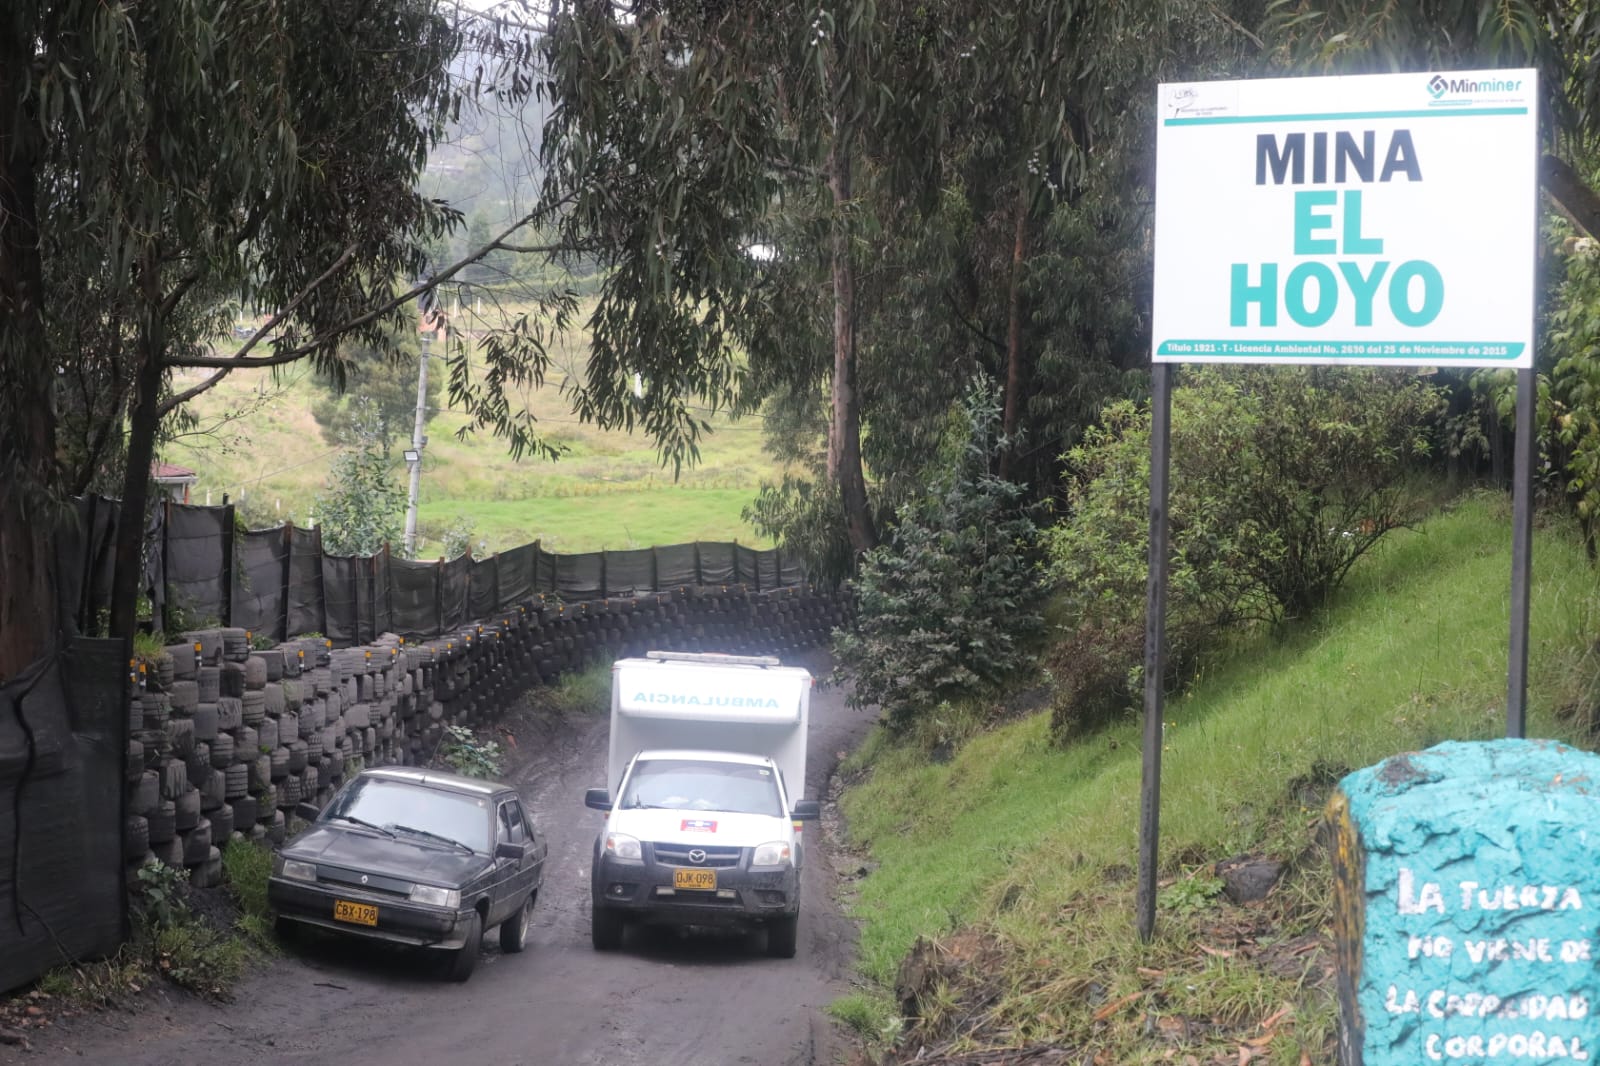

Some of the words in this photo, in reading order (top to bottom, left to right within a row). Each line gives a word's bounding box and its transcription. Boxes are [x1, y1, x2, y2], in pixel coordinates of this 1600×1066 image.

[1450, 78, 1522, 93] Minminer
[1255, 129, 1423, 185] MINA
[1293, 190, 1384, 255] EL
[1230, 260, 1444, 327] HOYO
[1234, 344, 1272, 353] Licencia
[1274, 344, 1320, 354] Ambiental
[1366, 345, 1381, 354] del
[1383, 345, 1396, 354] 25
[1399, 345, 1412, 354] de
[1414, 345, 1465, 355] Noviembre
[1467, 346, 1480, 355] de
[1482, 346, 1508, 355] 2015
[1397, 868, 1445, 914] LA
[1407, 935, 1453, 959] NO
[1464, 938, 1553, 963] VIENE
[1560, 938, 1591, 962] DE
[1385, 983, 1419, 1014] LA
[1426, 1030, 1588, 1060] CORPORAL
